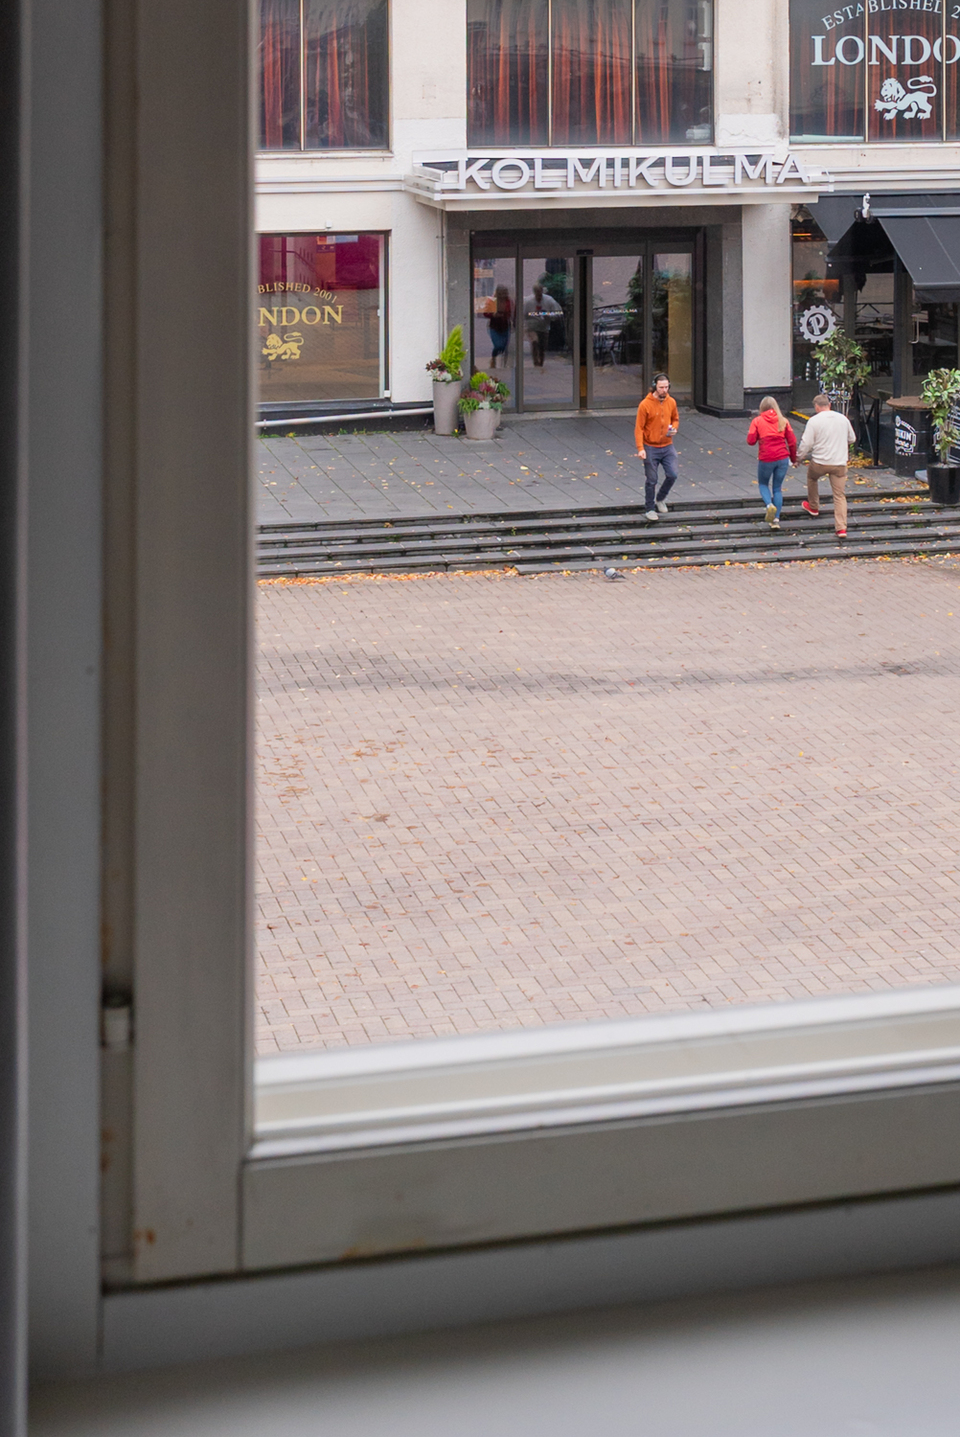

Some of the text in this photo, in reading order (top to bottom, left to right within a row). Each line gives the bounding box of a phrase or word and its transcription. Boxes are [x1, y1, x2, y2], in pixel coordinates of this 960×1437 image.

[458, 153, 812, 191] KOLMIKULMA
[313, 288, 338, 304] 2001
[258, 305, 344, 327] NDON
